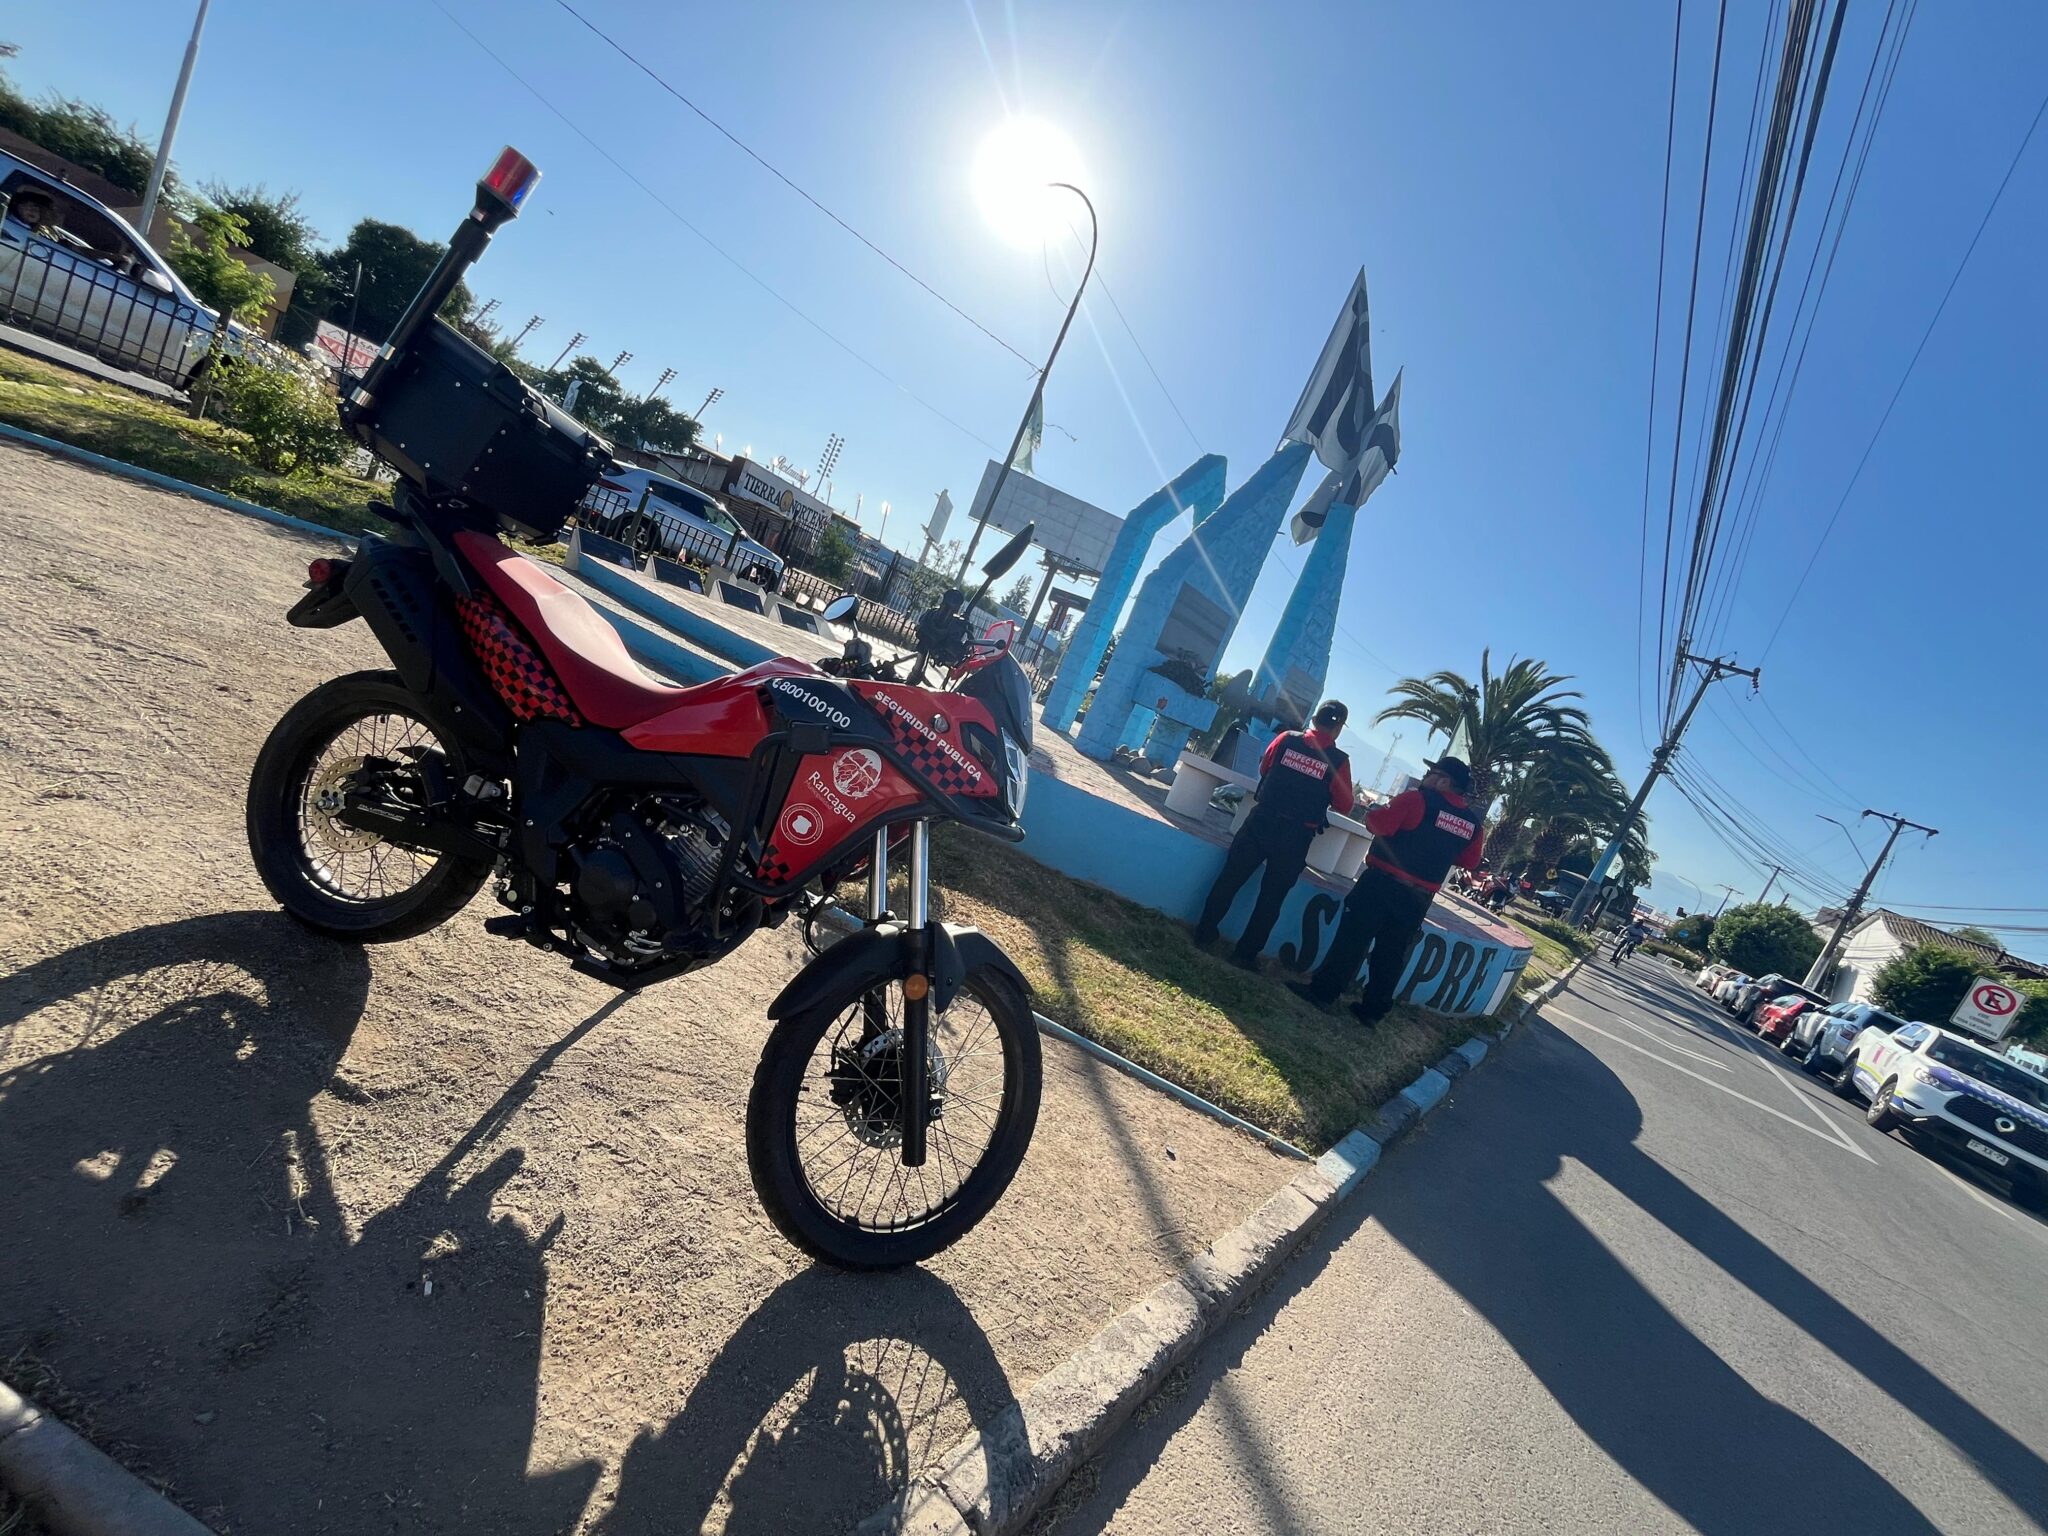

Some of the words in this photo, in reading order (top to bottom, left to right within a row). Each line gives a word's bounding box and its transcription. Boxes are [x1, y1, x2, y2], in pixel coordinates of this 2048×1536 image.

[743, 473, 782, 507] TIERRA
[780, 682, 851, 728] 800100100
[875, 691, 937, 741] SEGURIDAD
[937, 740, 982, 782] PÚBLICA
[1282, 757, 1322, 778] MUNICIPAL
[1285, 749, 1328, 771] INSPECTOR
[808, 770, 856, 823] Rancagua
[1436, 818, 1472, 839] MUNICIPAL
[1439, 810, 1474, 831] INSPECTOR
